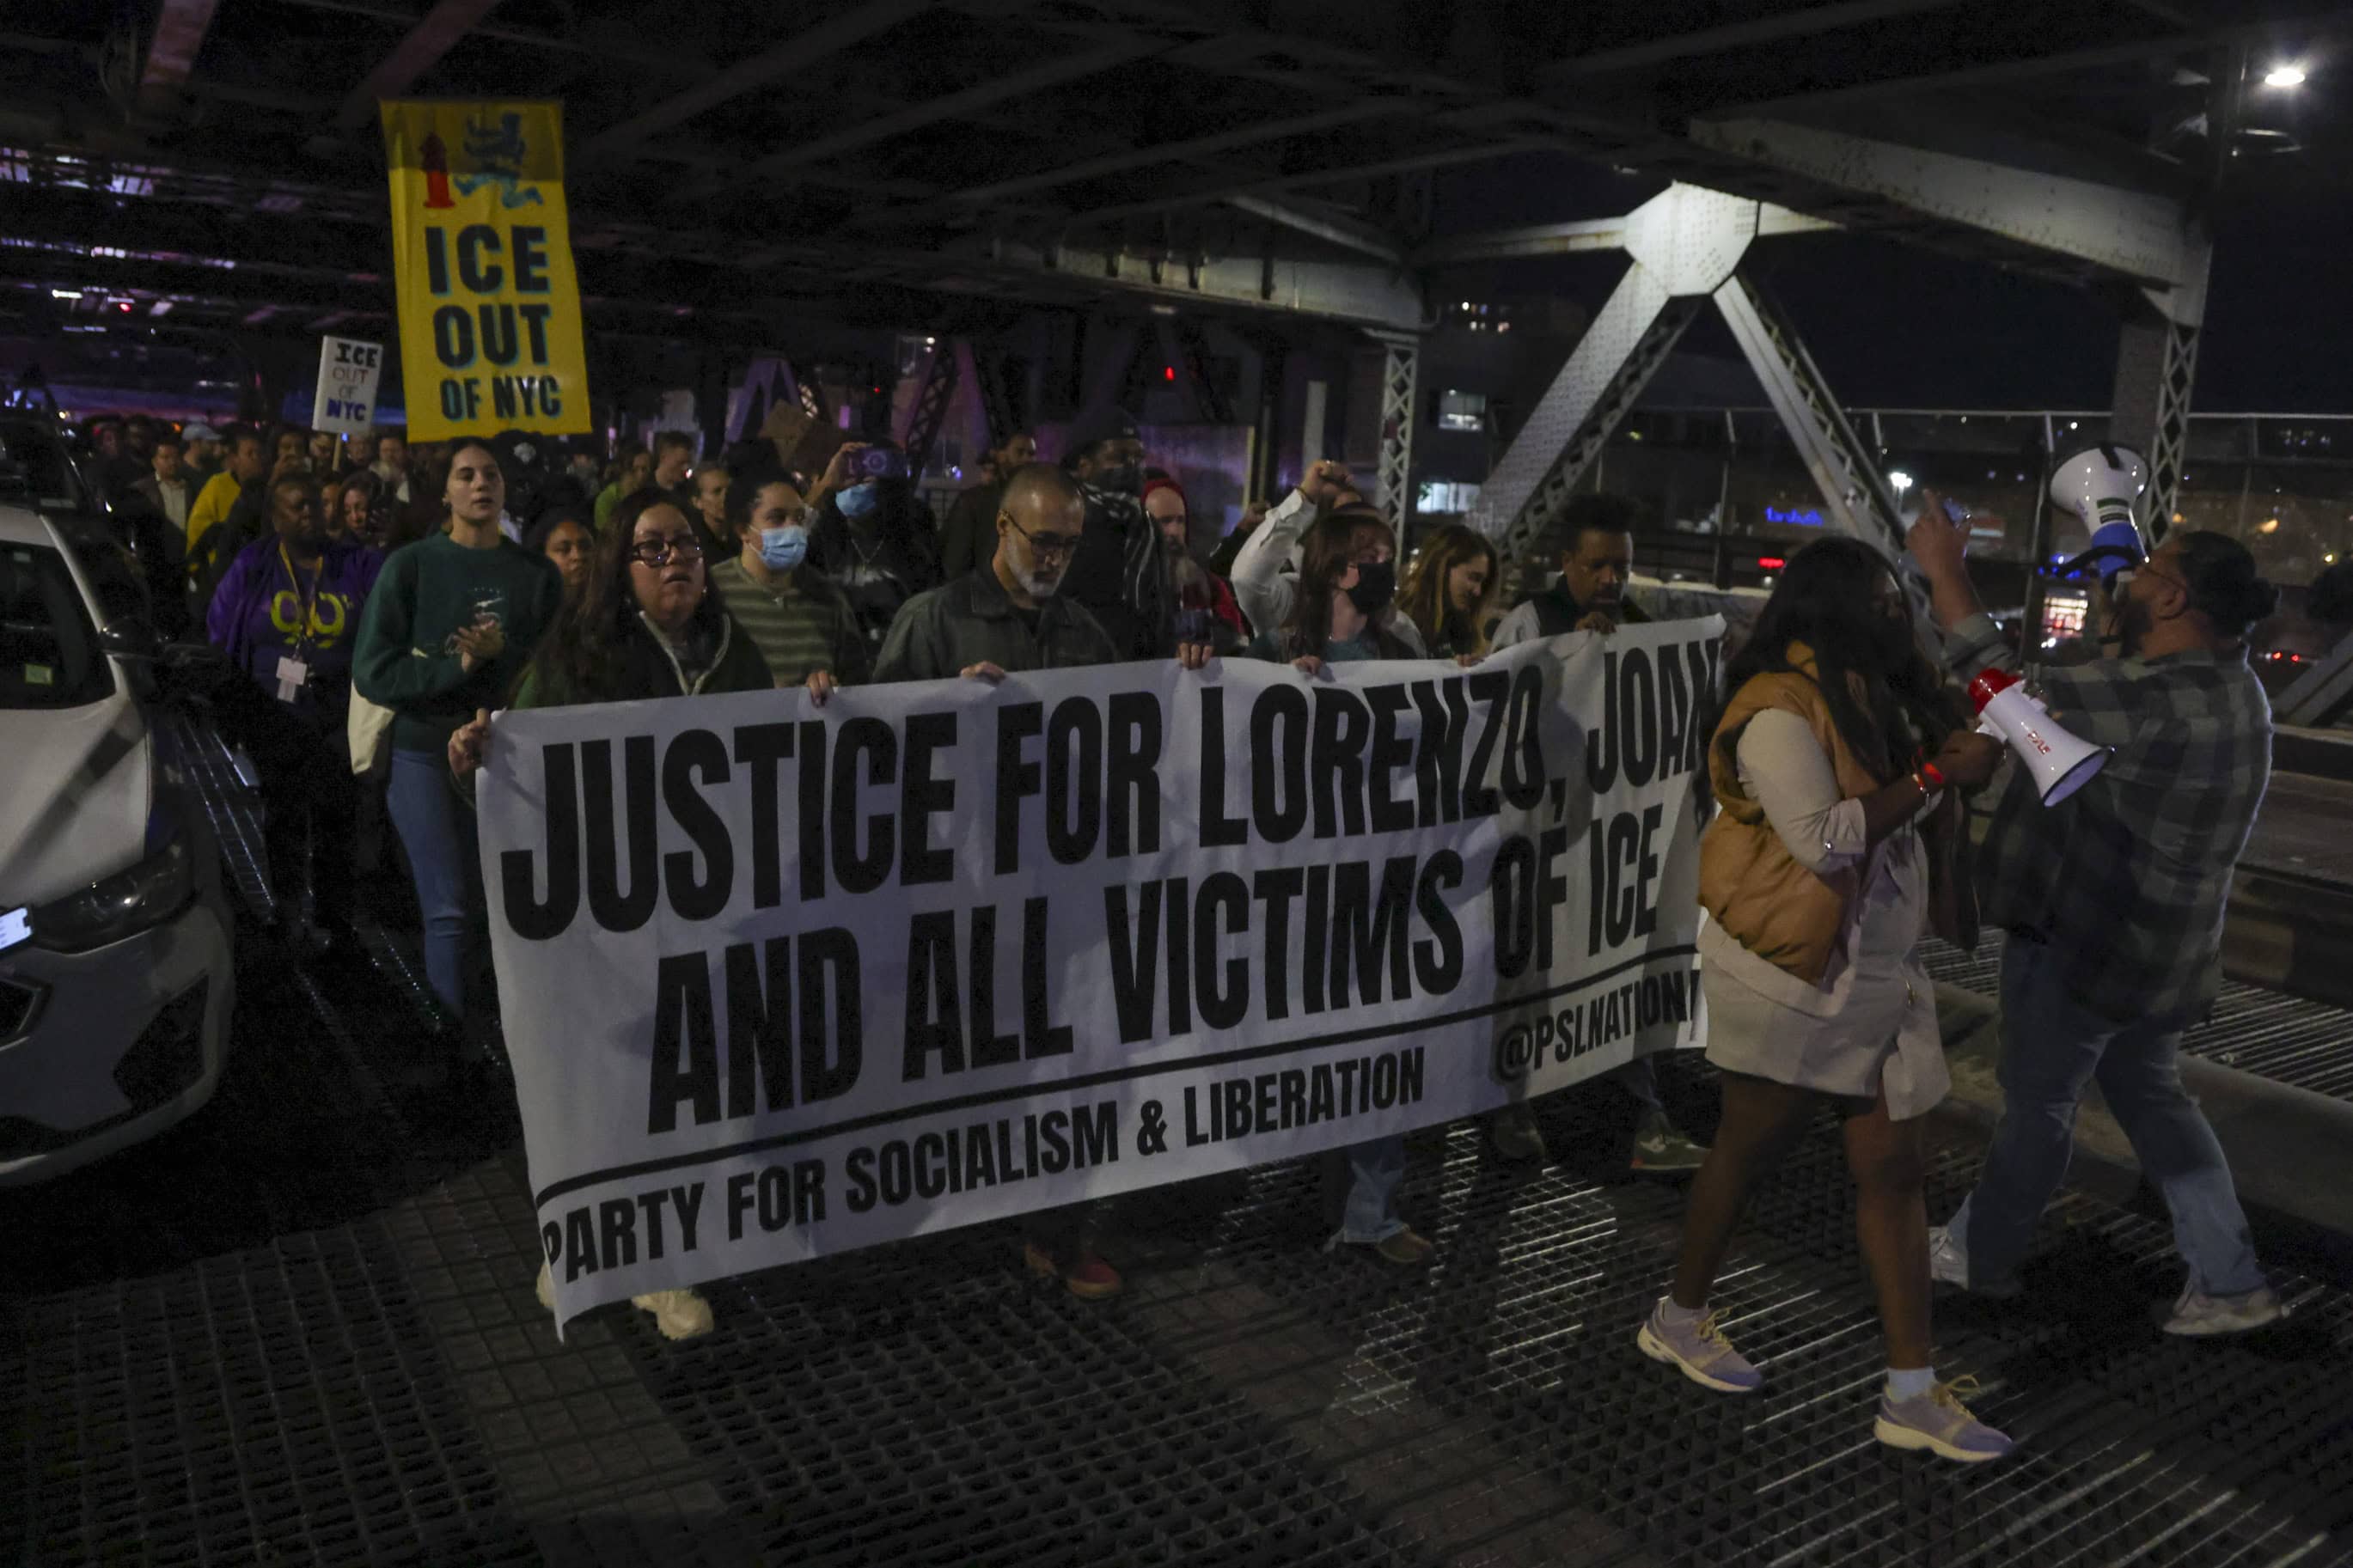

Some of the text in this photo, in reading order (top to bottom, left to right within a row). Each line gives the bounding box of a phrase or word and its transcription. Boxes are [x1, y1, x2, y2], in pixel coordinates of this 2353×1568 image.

[425, 224, 551, 296] ICE
[334, 343, 378, 368] ICE
[432, 303, 551, 369] OUT
[332, 367, 370, 384] OUT
[440, 375, 563, 421] OF NYC
[327, 398, 367, 422] NYC
[501, 712, 957, 940] JUSTICE
[994, 691, 1163, 875] FOR
[1199, 664, 1567, 847] LORENZO,
[648, 803, 1664, 1135] AND ALL VICTIMS OF ICE
[542, 1046, 1425, 1284] PARTY FOR SOCIALISM & LIBERATION
